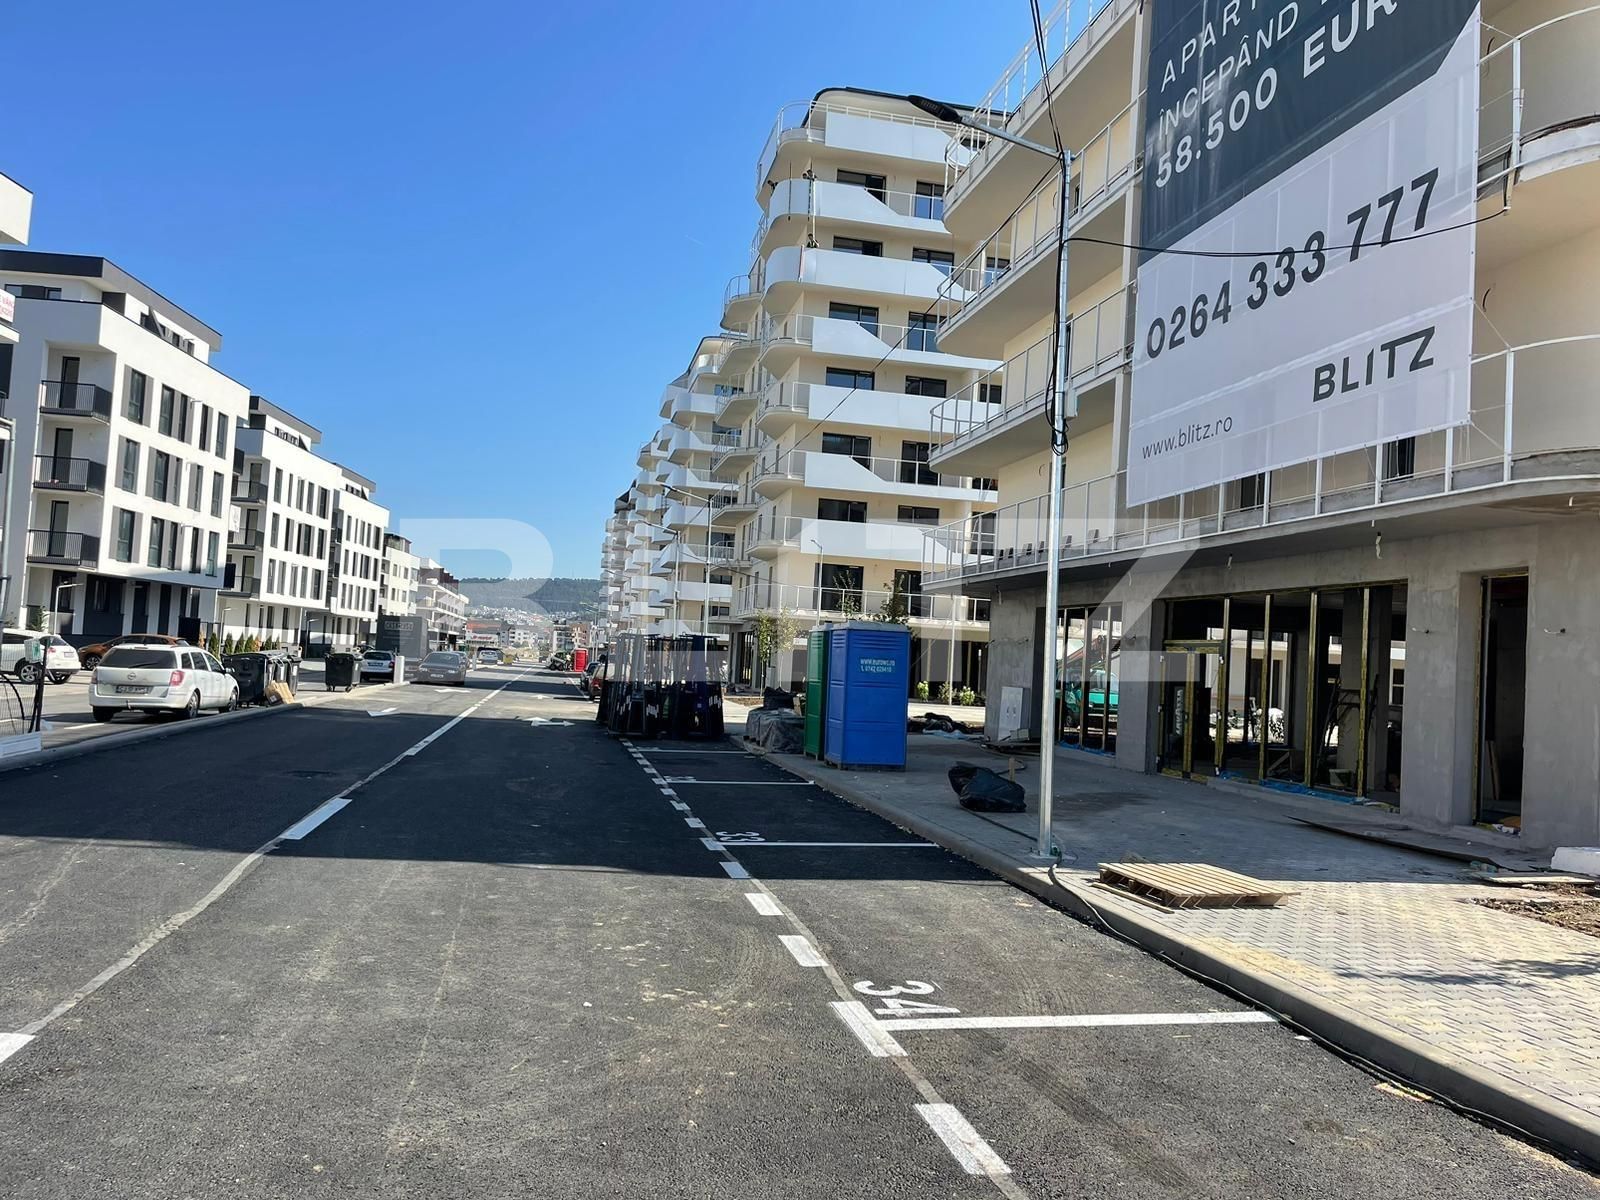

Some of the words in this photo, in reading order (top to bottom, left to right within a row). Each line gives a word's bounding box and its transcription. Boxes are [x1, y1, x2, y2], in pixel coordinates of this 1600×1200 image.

[1158, 2, 1299, 140] ÎNCEPÂND
[1155, 67, 1278, 188] 58.500
[1147, 279, 1232, 359] 0264
[1247, 230, 1326, 310] 333
[1347, 167, 1439, 262] 777
[1313, 326, 1435, 402] BLITZ
[1142, 416, 1233, 459] www.blitz.ro
[853, 980, 961, 1018] 34
